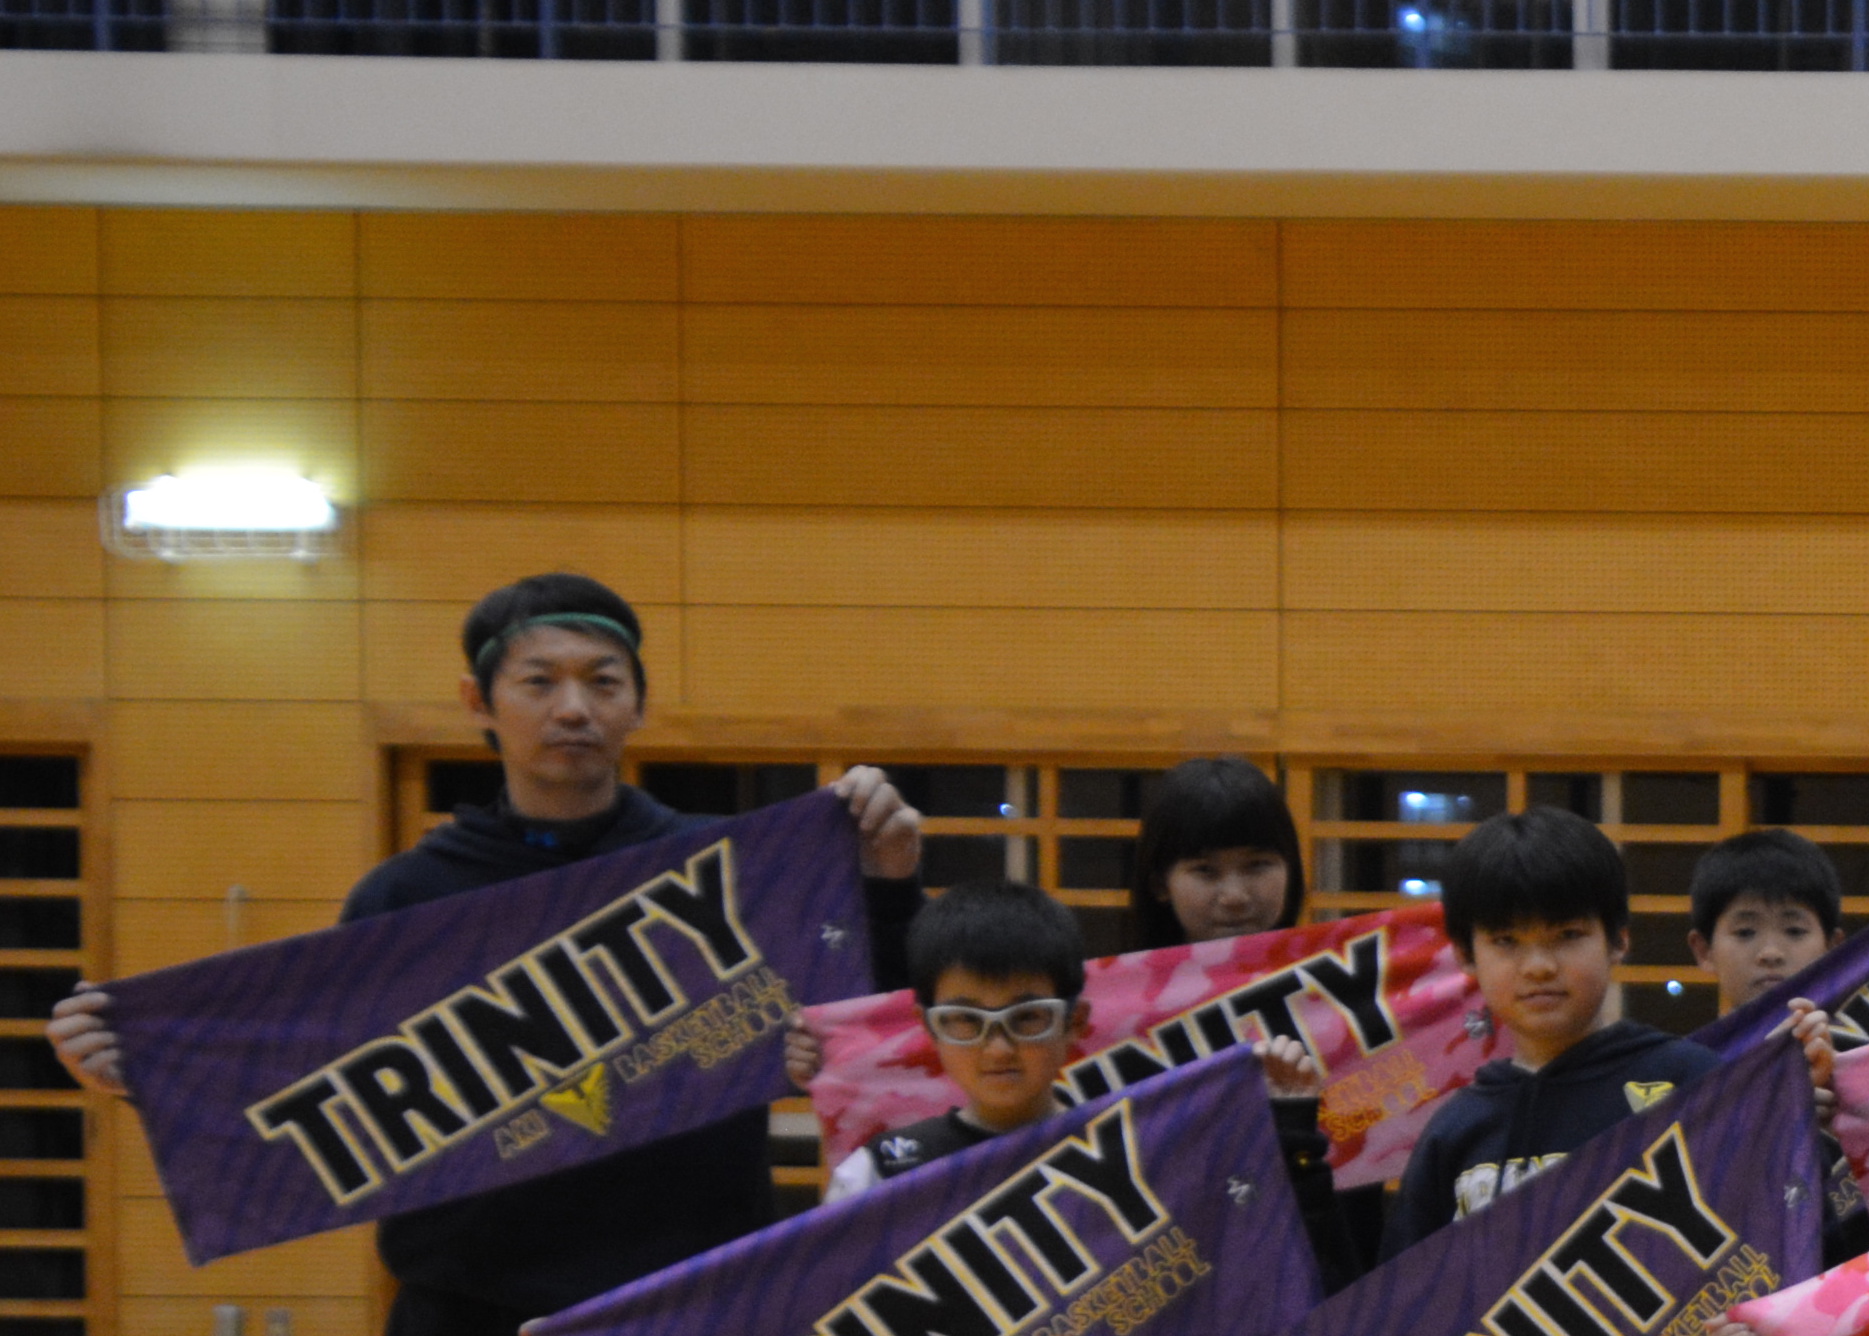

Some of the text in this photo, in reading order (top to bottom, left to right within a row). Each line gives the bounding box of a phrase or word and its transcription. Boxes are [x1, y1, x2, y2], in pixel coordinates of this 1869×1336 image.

[246, 837, 761, 1206] TRINITY
[613, 966, 789, 1084] BASKETBALL
[1104, 1251, 1212, 1336] SCHOOL
